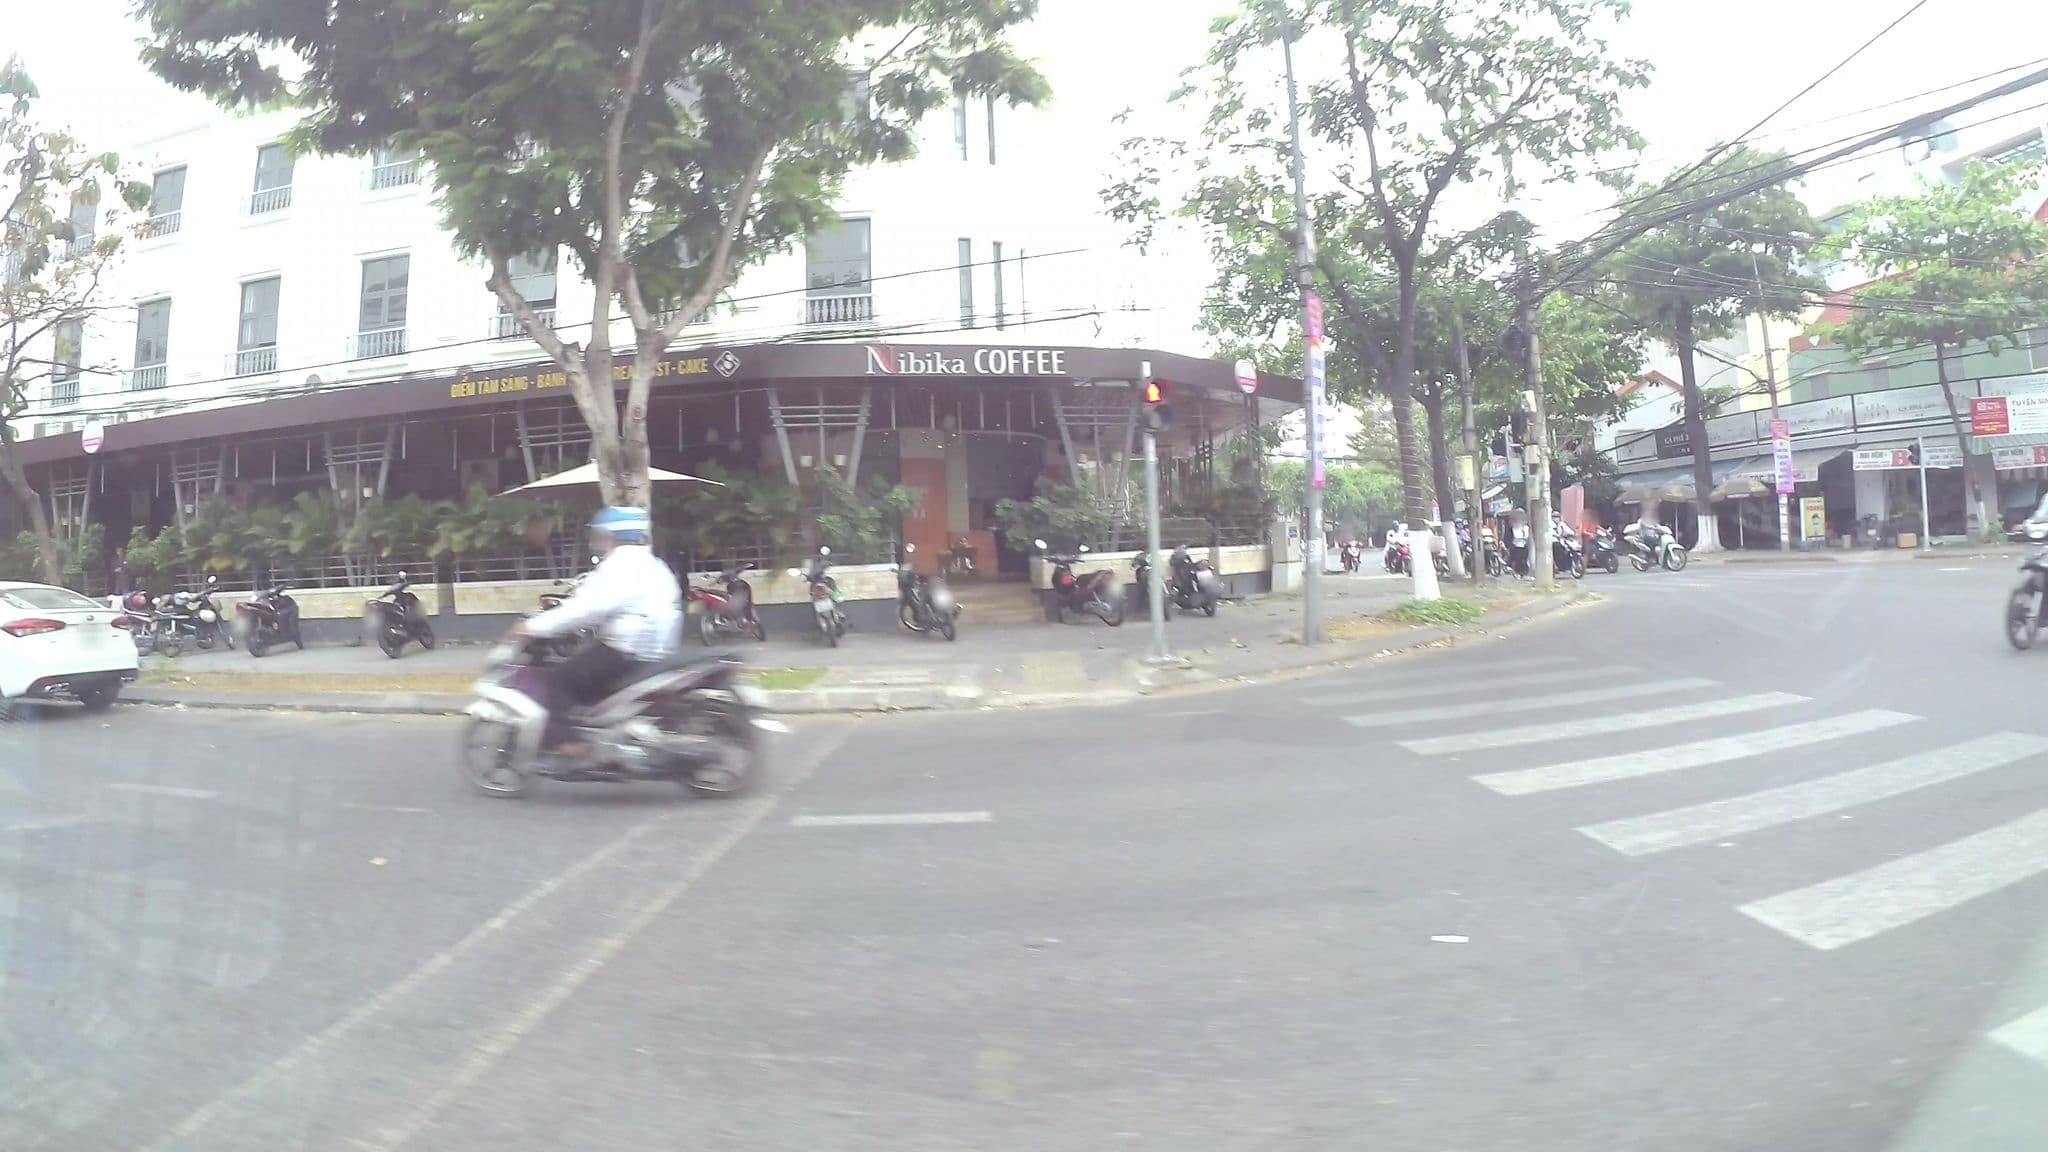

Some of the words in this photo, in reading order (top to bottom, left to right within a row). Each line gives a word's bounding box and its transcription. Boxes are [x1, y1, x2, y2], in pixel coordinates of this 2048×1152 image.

[677, 358, 709, 374] CAKE
[865, 345, 967, 374] Nibika
[974, 349, 1067, 375] COFFEE
